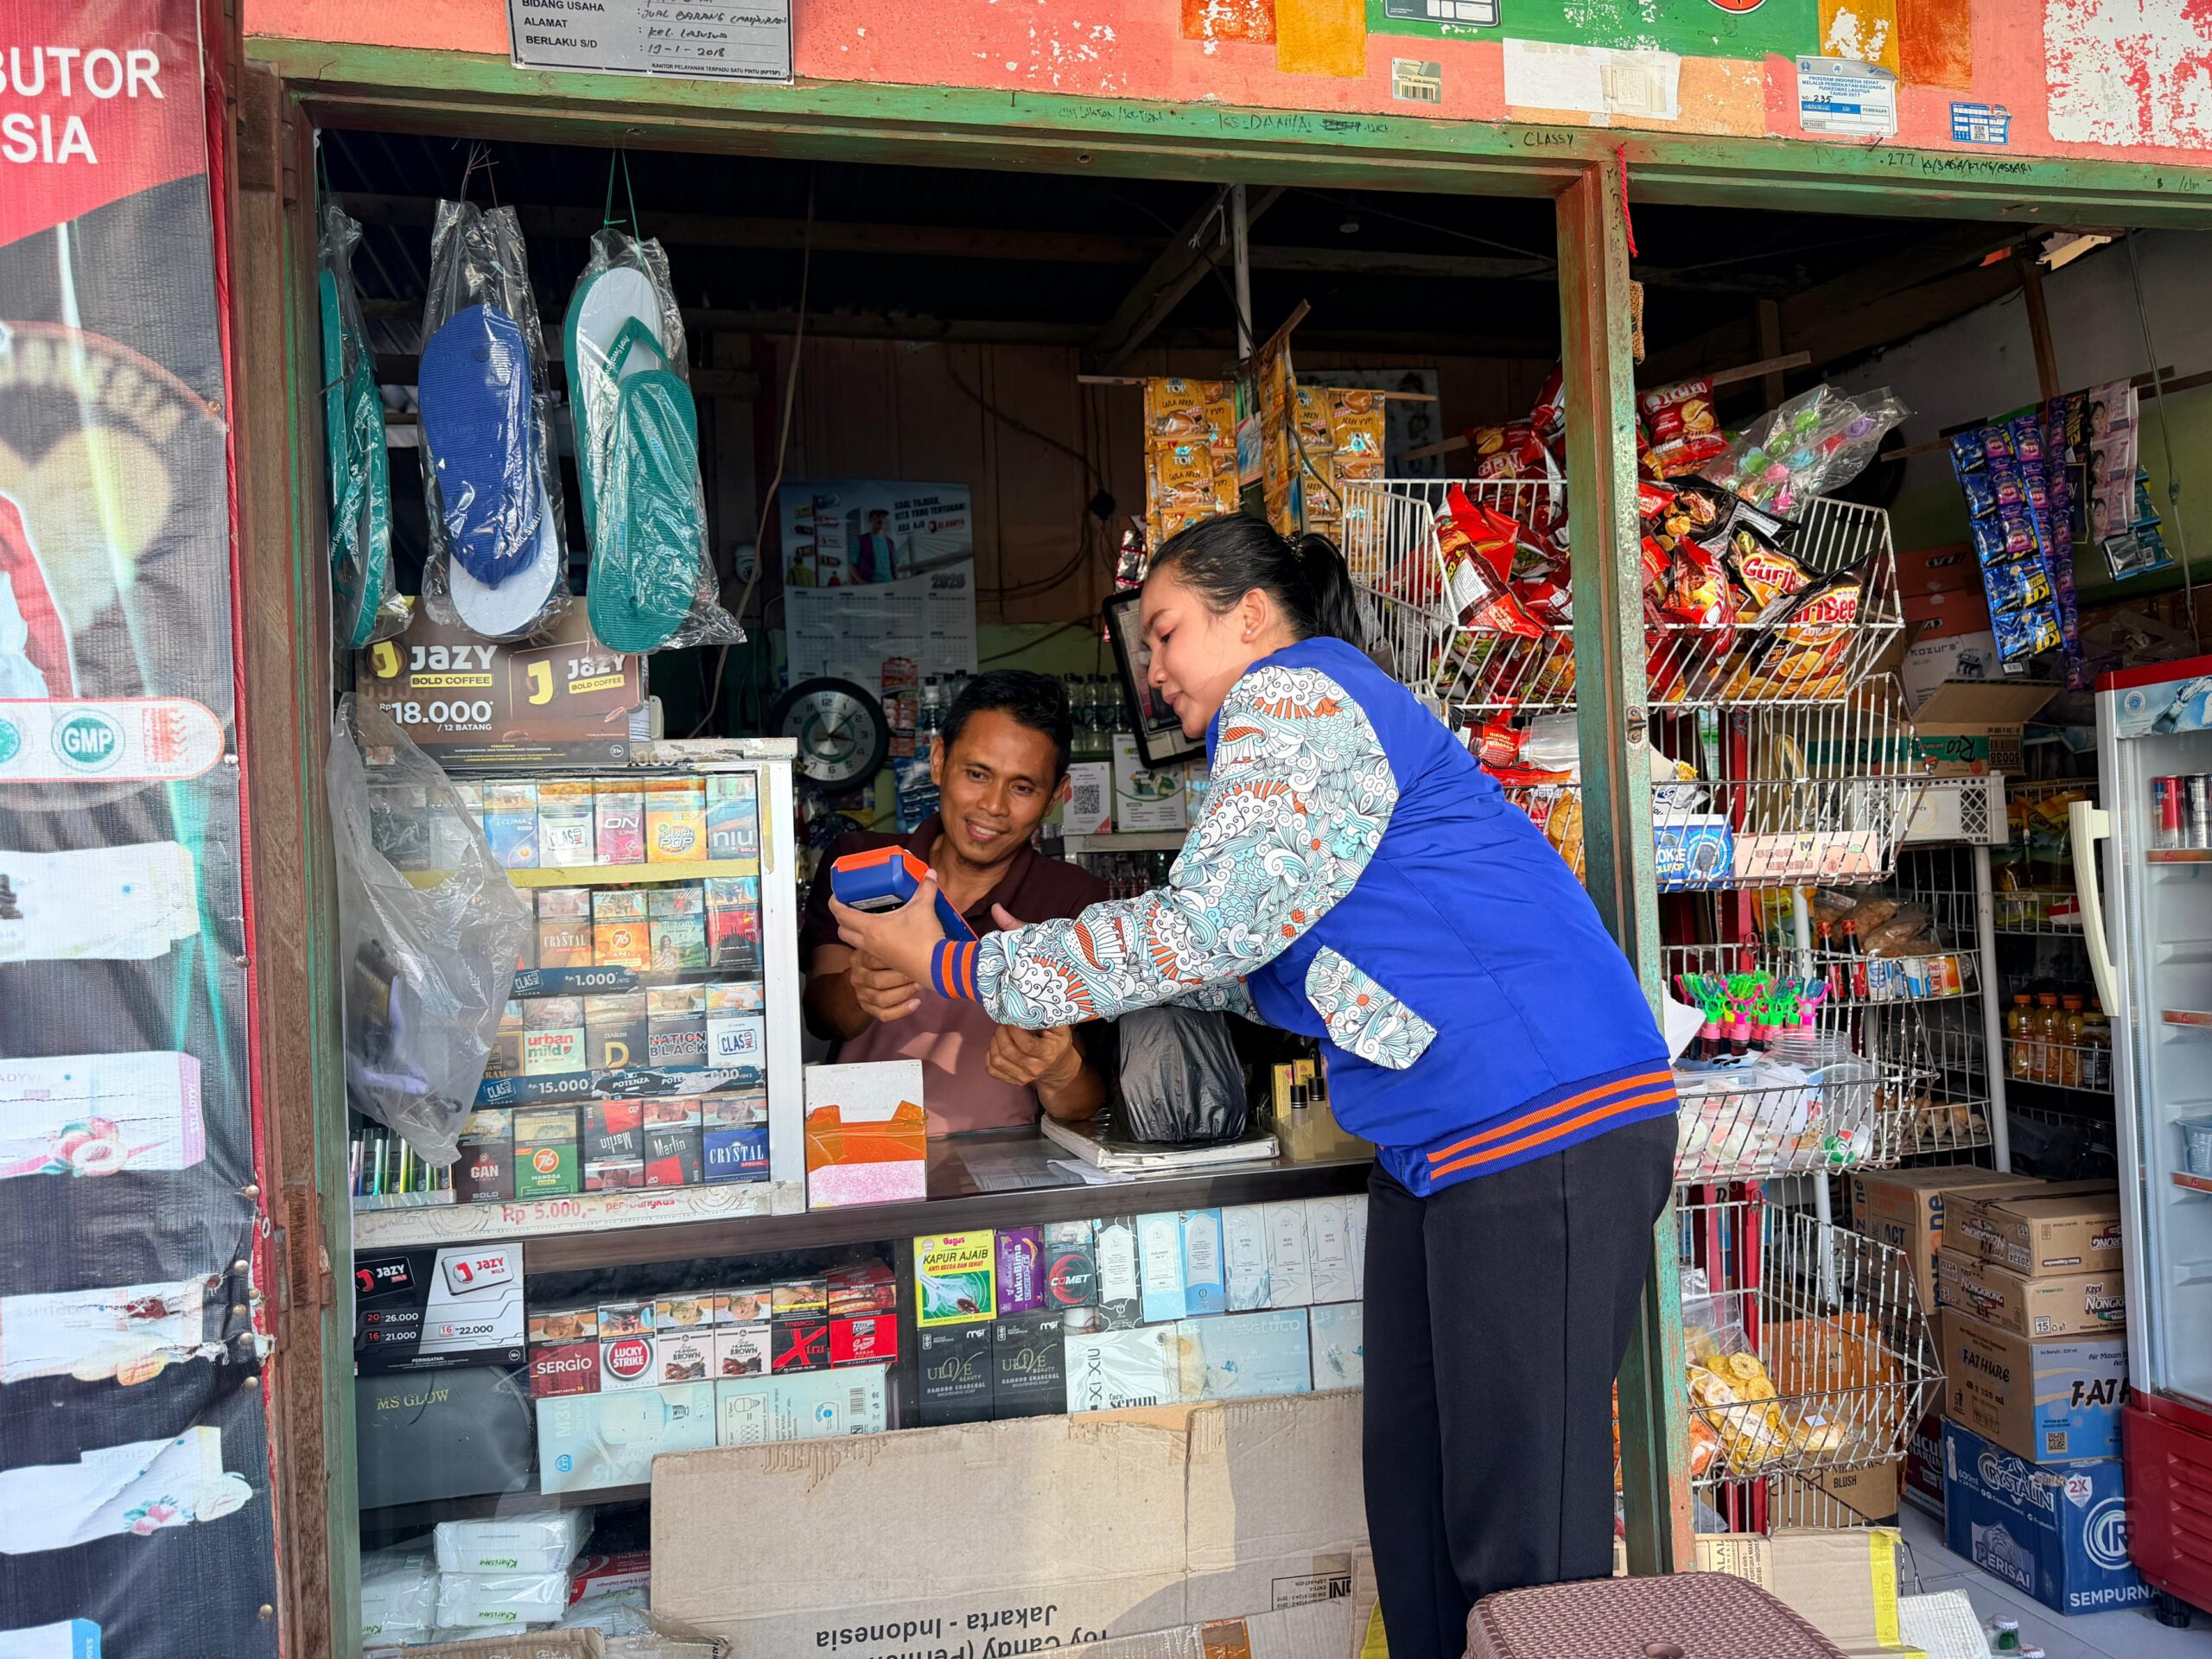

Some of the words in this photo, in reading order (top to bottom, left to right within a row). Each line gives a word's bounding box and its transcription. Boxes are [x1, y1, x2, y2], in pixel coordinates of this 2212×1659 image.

[523, 0, 564, 9] BIDANG
[567, 2, 605, 12] USAHA
[524, 17, 568, 28] ALAMAT
[676, 10, 725, 22] BARANG
[526, 35, 577, 47] BERLAKU
[581, 39, 598, 48] S/D
[0, 46, 166, 99] UTOR
[1523, 131, 1574, 147] CLASSY
[1166, 385, 1187, 393] TOP
[1173, 455, 1194, 465] TOP
[572, 682, 592, 690] BOLD
[594, 677, 622, 686] COFFEE
[64, 727, 113, 753] GMP
[605, 817, 639, 830] ON
[660, 837, 693, 849] POP
[543, 935, 587, 947] CRYSTAL
[575, 973, 615, 986] 1.000
[527, 1033, 573, 1046] urban
[649, 1031, 706, 1045] NATION
[528, 1045, 562, 1057] mild
[605, 1042, 629, 1068] D
[650, 1043, 707, 1058] BLACK
[539, 1080, 588, 1093] 15.000
[613, 1077, 650, 1089] POTENZA
[600, 1131, 632, 1154] Marlin
[653, 1135, 686, 1157] Marlin
[537, 1151, 556, 1171] 76
[709, 1144, 764, 1165] CRYSTAL
[471, 1164, 499, 1179] GAN
[503, 1205, 525, 1224] Rp
[943, 1236, 965, 1246] Bagus
[1884, 1224, 1905, 1245] ACT
[923, 1251, 957, 1265] KAPUR
[959, 1249, 988, 1261] AJAIB
[1014, 1243, 1023, 1303] KukuBima
[1051, 1274, 1092, 1287] COMET
[1961, 1277, 2005, 1303] NONGKRONG
[2085, 1285, 2103, 1294] Kopi
[2037, 1322, 2050, 1332] 15
[614, 1345, 643, 1357] LUCKY
[673, 1352, 701, 1361] BROWN
[730, 1347, 758, 1356] BROWN
[613, 1357, 644, 1369] STRIKE
[1963, 1349, 2010, 1382] FATHURE
[377, 1395, 399, 1410] MS
[404, 1389, 449, 1408] GLOW
[1834, 1476, 1857, 1489] BLUSH
[2069, 1480, 2088, 1493] 2X
[1975, 1541, 2031, 1588] PERISAI
[479, 1611, 518, 1622] Kharisma
[967, 1604, 1058, 1630] Jakarta
[816, 1618, 941, 1651] Indonesia
